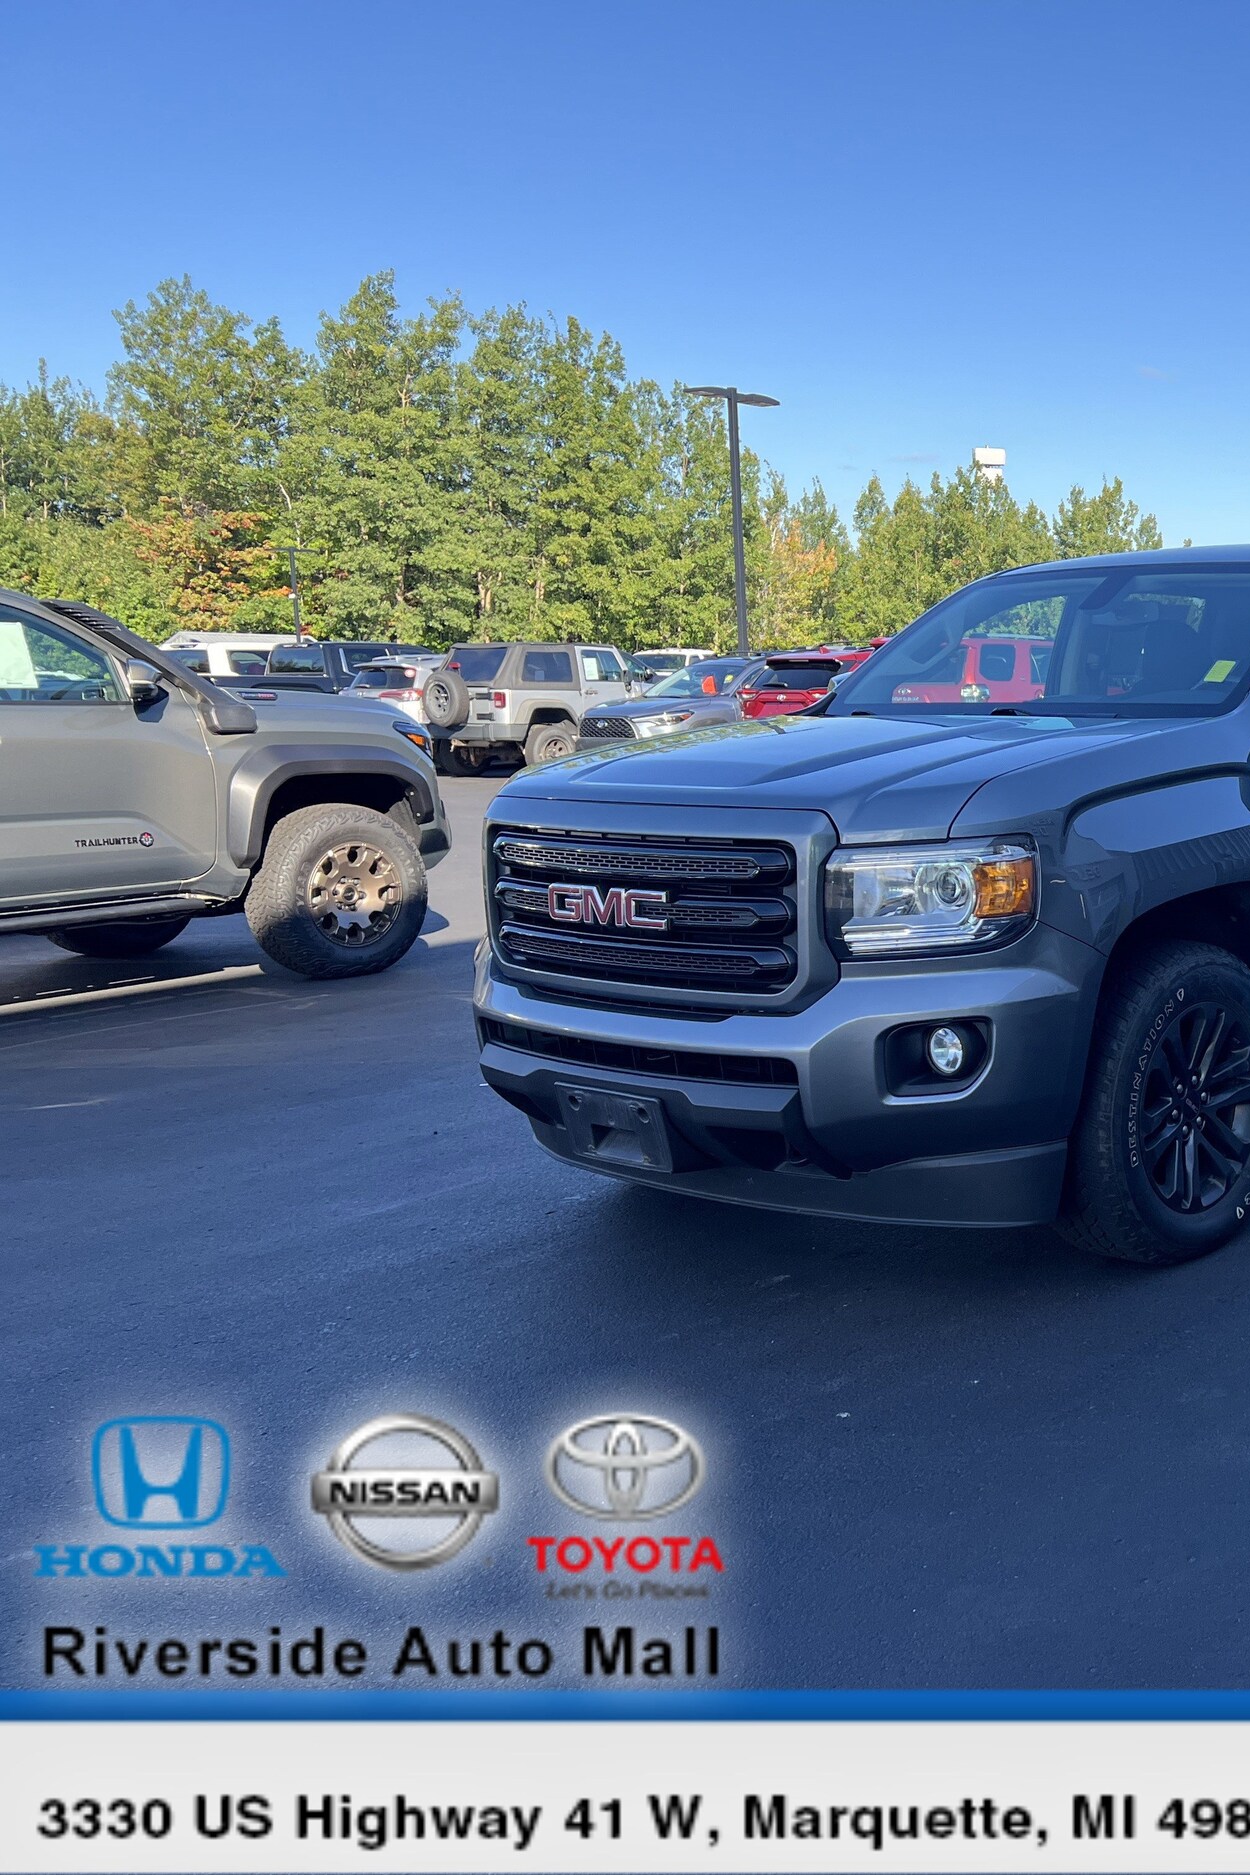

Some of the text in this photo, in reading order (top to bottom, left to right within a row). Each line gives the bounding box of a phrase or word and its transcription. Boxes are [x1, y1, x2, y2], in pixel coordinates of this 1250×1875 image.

[75, 837, 139, 847] TRAILHUNTER
[548, 882, 668, 931] GMC
[1128, 1000, 1175, 1167] DESTINATION
